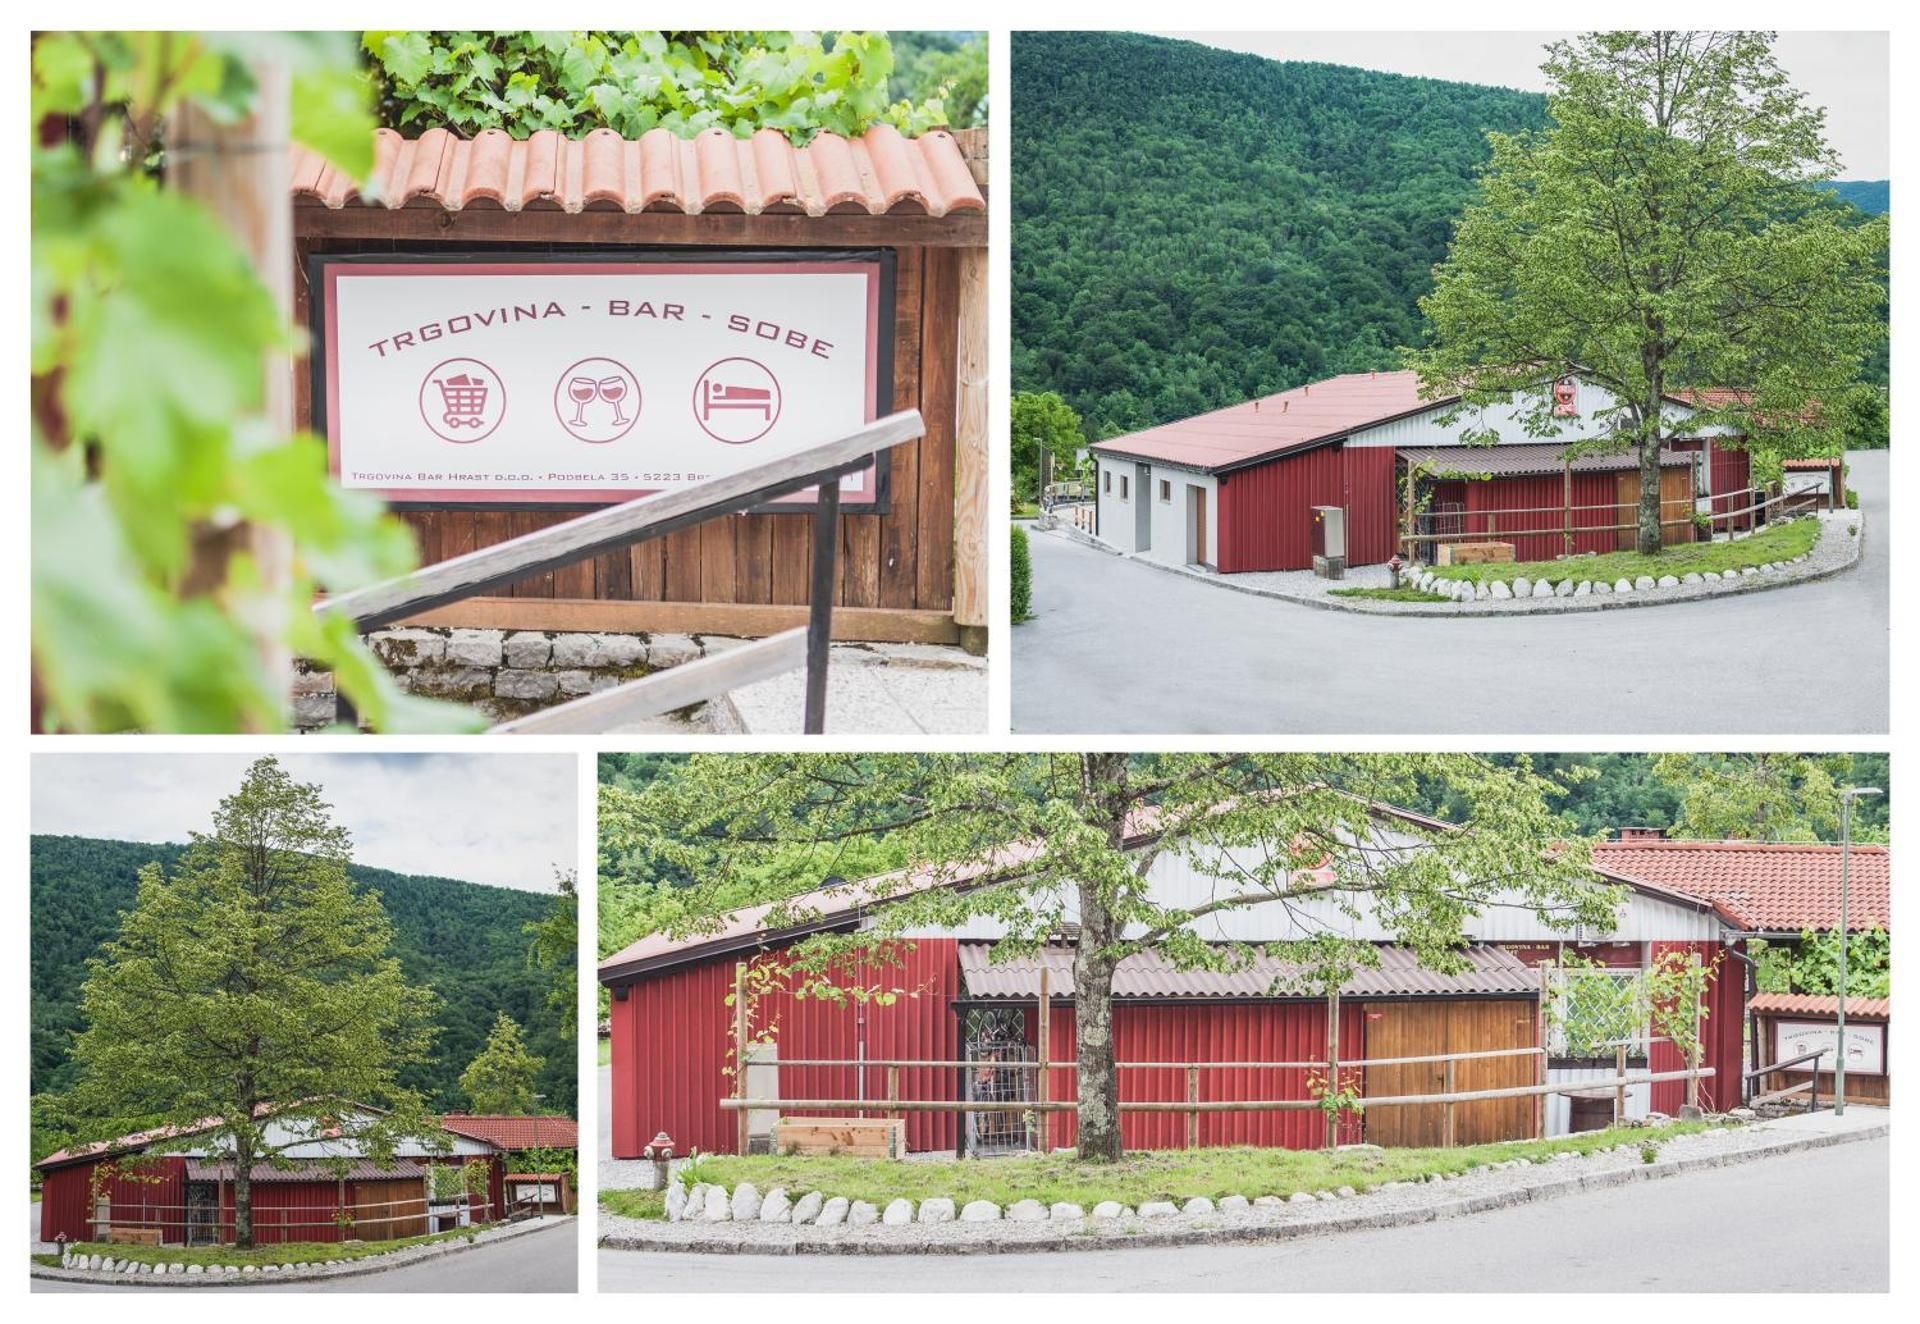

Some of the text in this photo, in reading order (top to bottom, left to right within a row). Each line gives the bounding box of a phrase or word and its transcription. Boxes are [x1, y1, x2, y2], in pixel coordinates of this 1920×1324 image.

[368, 302, 566, 358] TRGOVINA
[608, 299, 685, 321] BAR
[727, 314, 835, 360] SOBE
[610, 472, 630, 481] 35
[643, 472, 681, 481] 5223
